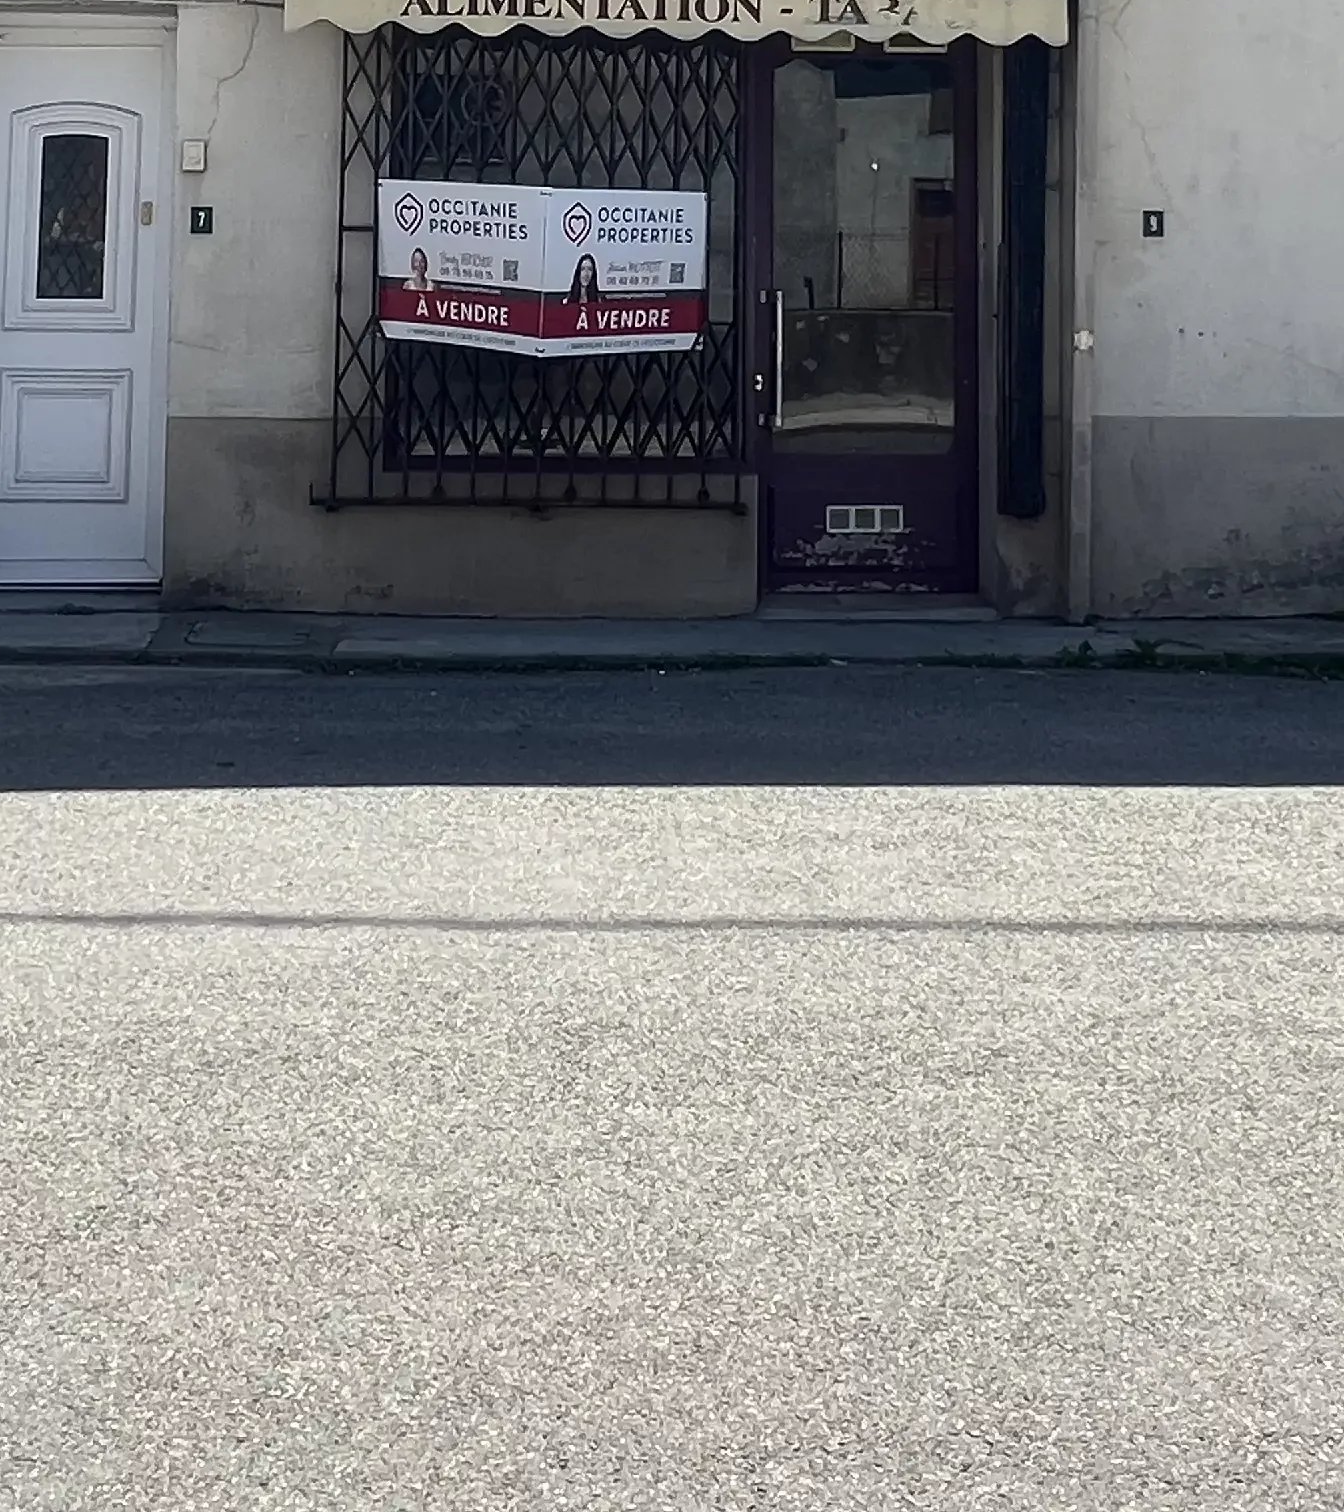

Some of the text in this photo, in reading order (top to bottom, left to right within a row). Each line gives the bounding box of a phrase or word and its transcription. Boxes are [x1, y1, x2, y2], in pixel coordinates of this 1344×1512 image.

[198, 210, 206, 228] 7
[428, 198, 519, 220] OCCITANIE
[597, 206, 685, 225] OCCITANIE
[428, 218, 529, 241] PROPERTIES
[597, 226, 694, 244] PROPERTIES
[415, 292, 510, 328] À VENDRE
[575, 306, 672, 332] À VENDRE
